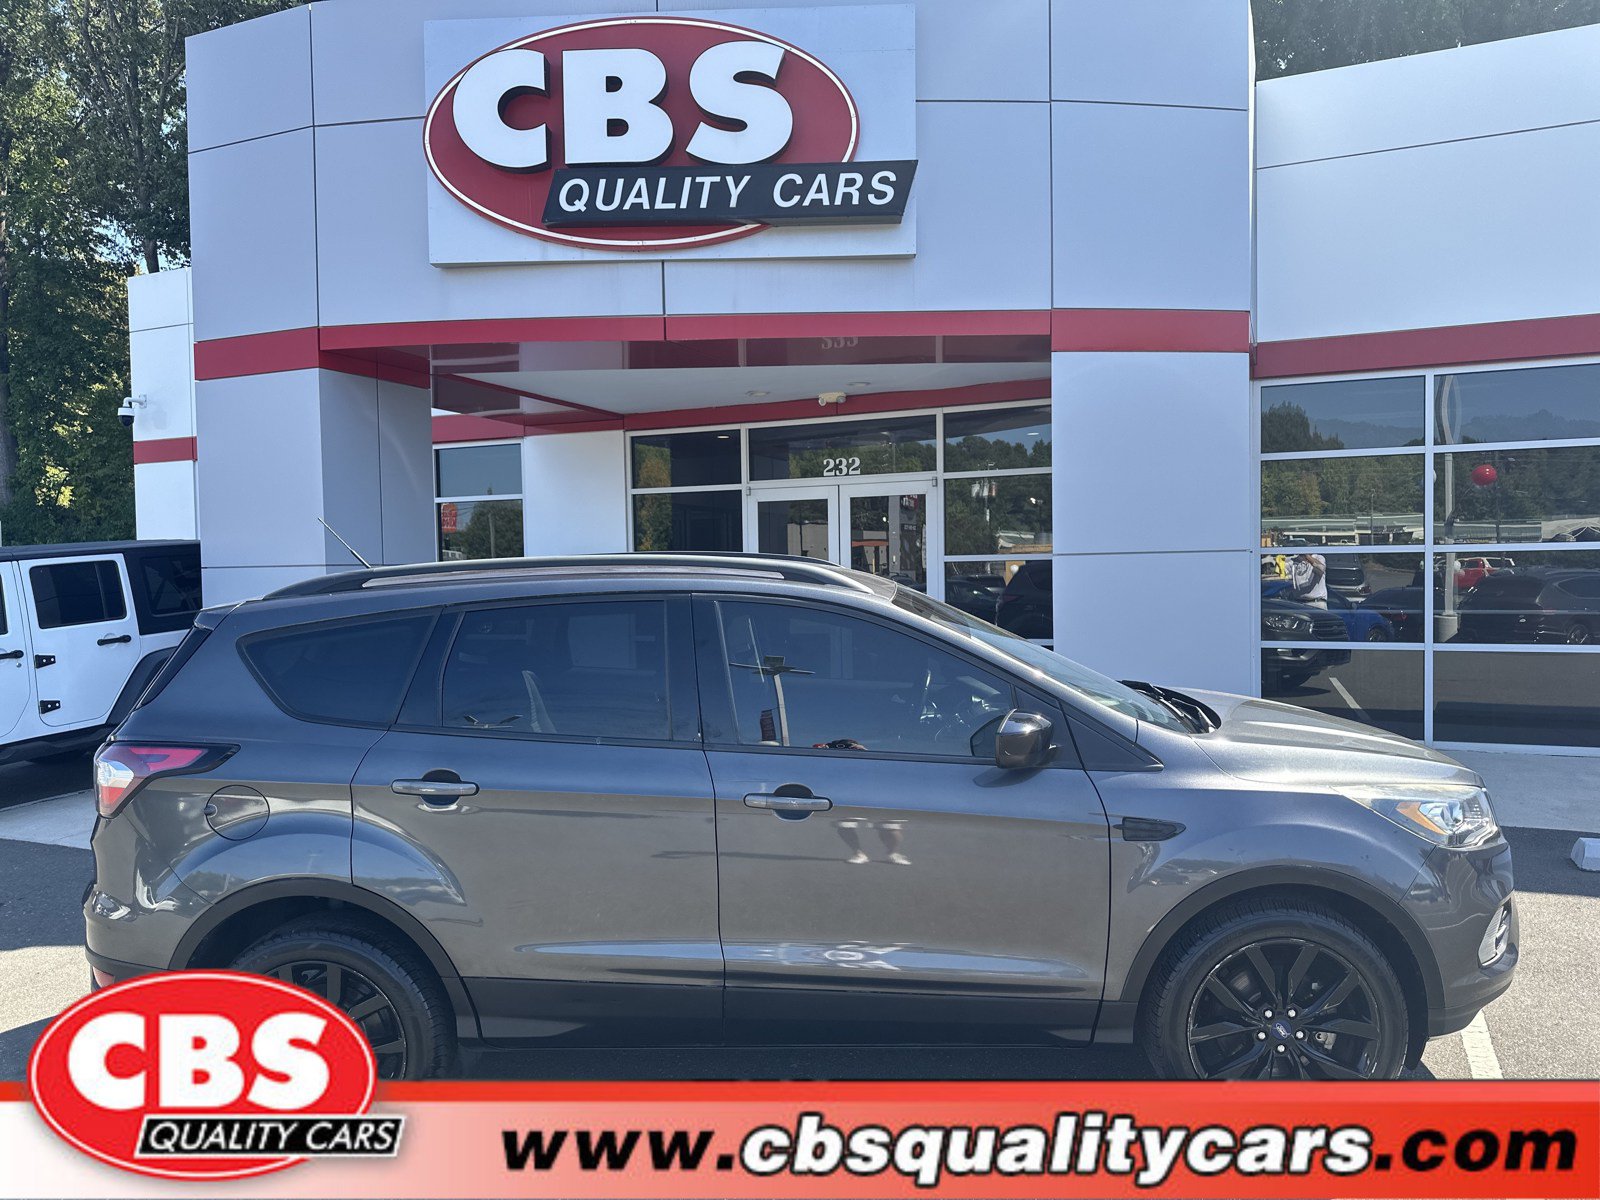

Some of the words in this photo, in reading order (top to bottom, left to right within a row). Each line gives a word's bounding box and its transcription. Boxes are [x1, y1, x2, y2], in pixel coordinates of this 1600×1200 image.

[453, 41, 793, 170] CBS
[559, 176, 752, 212] QUALITY
[773, 171, 897, 208] CARS
[823, 457, 861, 477] 232
